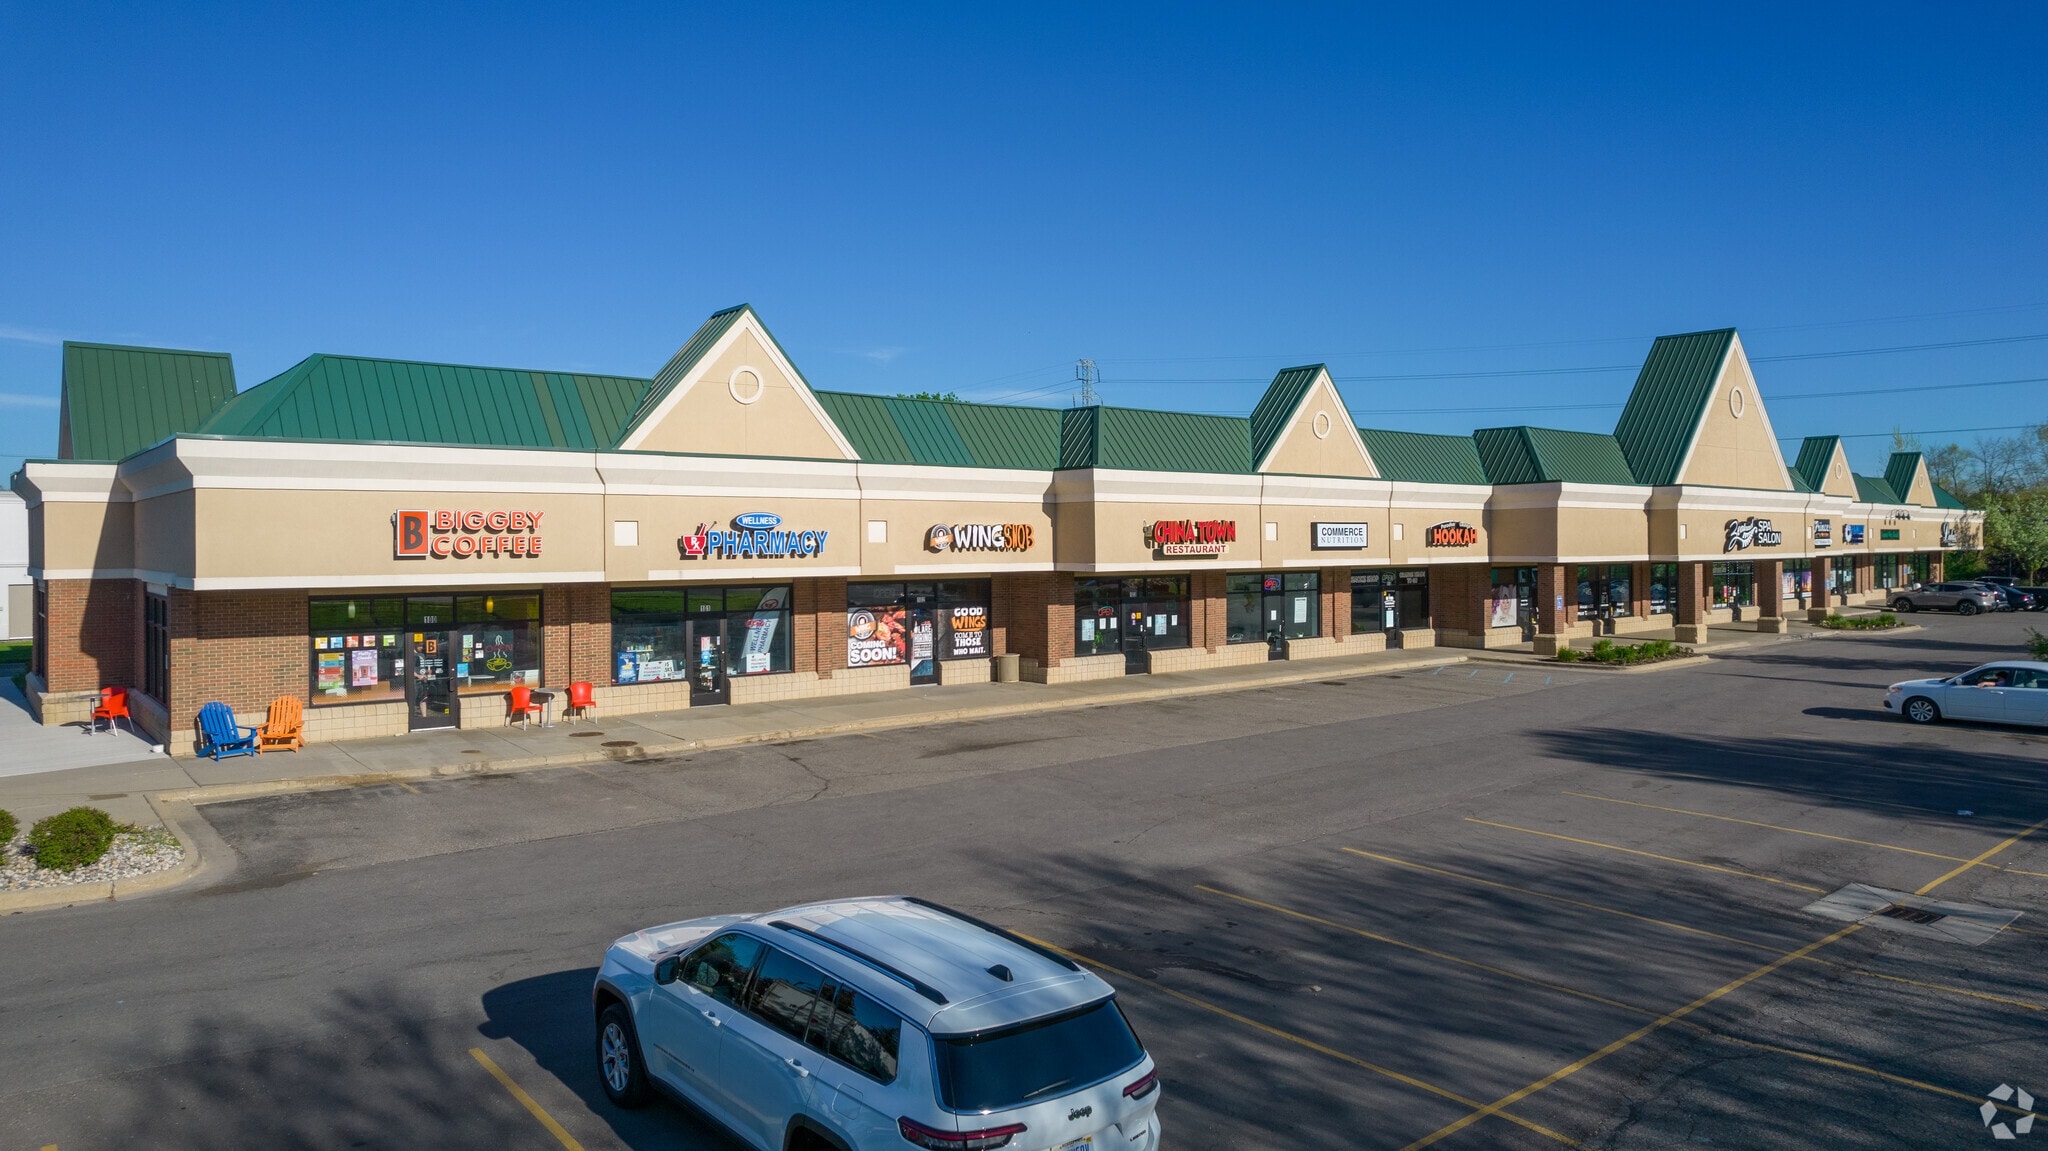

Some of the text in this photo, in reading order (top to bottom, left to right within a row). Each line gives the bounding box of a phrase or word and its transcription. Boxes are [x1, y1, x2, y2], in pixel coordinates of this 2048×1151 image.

[436, 510, 545, 530] BIGGBY
[741, 516, 778, 525] WELLNESS
[1758, 520, 1772, 532] SPA
[1154, 520, 1236, 543] CHINA TOWN
[1321, 527, 1363, 537] COMMERCE
[1433, 528, 1478, 545] HOOKAH
[708, 530, 829, 555] PHARMACY
[1321, 536, 1364, 544] NUTRITION
[1758, 532, 1781, 544] SALON
[432, 536, 543, 555] COFFEE
[1166, 545, 1226, 554] RESTAURANT
[954, 607, 983, 617] GOOD
[951, 615, 986, 629] WINGS
[485, 643, 513, 653] OPEN
[850, 640, 886, 650] COMING
[955, 638, 981, 647] THOSE
[850, 647, 897, 663] SOON!
[1068, 1106, 1093, 1122] Jeep
